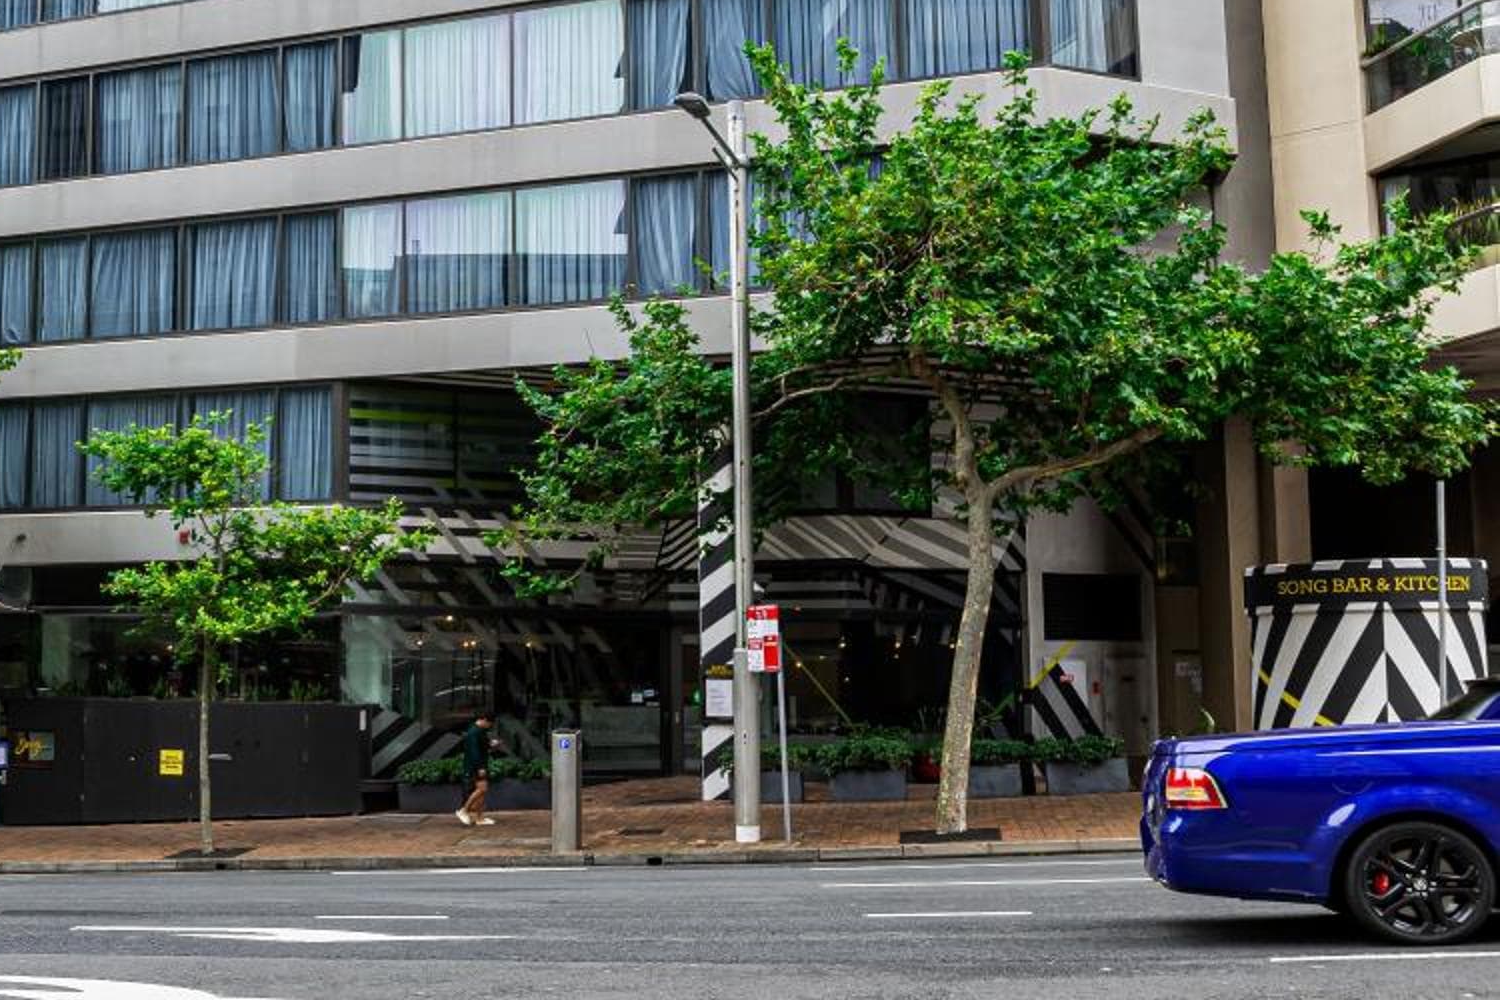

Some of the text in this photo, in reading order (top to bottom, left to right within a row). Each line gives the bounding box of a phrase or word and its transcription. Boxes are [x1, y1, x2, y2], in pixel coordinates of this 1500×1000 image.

[1277, 579, 1328, 595] SONG
[1332, 577, 1373, 593] BAR
[1376, 577, 1390, 592] &
